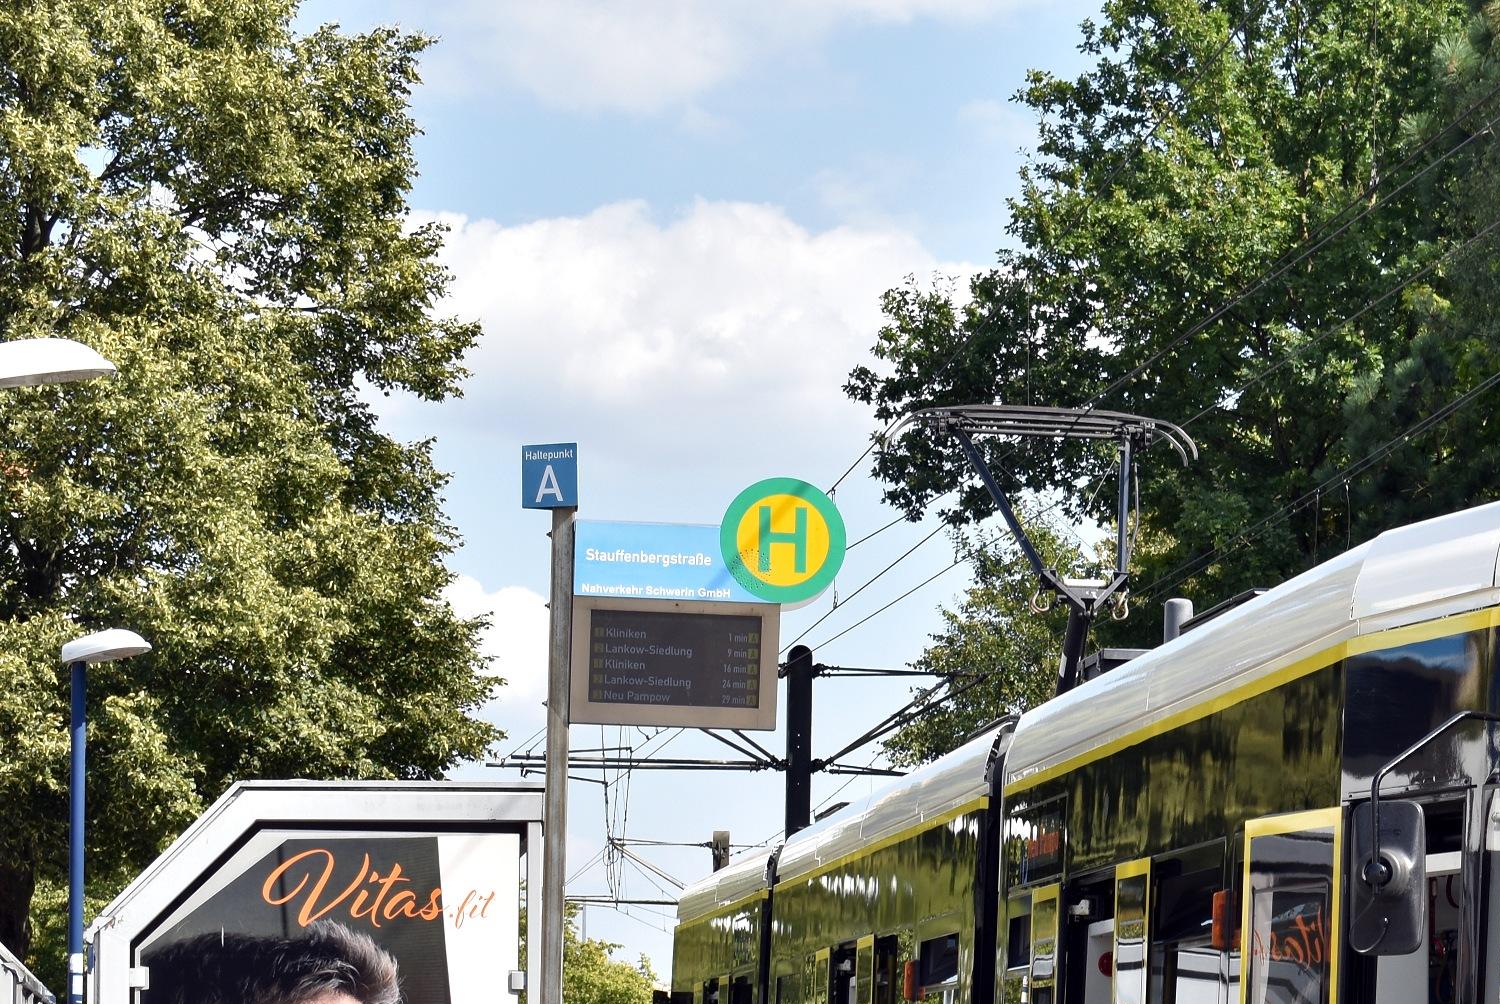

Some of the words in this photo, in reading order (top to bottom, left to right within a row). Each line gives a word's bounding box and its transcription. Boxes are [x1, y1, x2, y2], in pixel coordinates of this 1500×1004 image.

[525, 449, 573, 461] Haltepunkt
[535, 464, 564, 502] A
[758, 505, 807, 574] H
[585, 548, 712, 567] Stauffenbergstraße
[581, 583, 643, 595] Nahverkehr
[645, 585, 695, 597] Schwerin
[697, 587, 731, 598] GmbH
[605, 627, 647, 639] Kliniken
[734, 632, 748, 643] min
[605, 643, 692, 658] Lankow-Siedlung
[733, 648, 747, 658] min
[604, 659, 646, 670] Kliniken
[723, 663, 732, 673] 16
[733, 663, 747, 673] min
[604, 674, 691, 690] Lankow-Siedlung
[732, 679, 746, 689] min
[603, 690, 624, 700] Neu
[627, 690, 671, 703] Pampow
[732, 694, 745, 704] min
